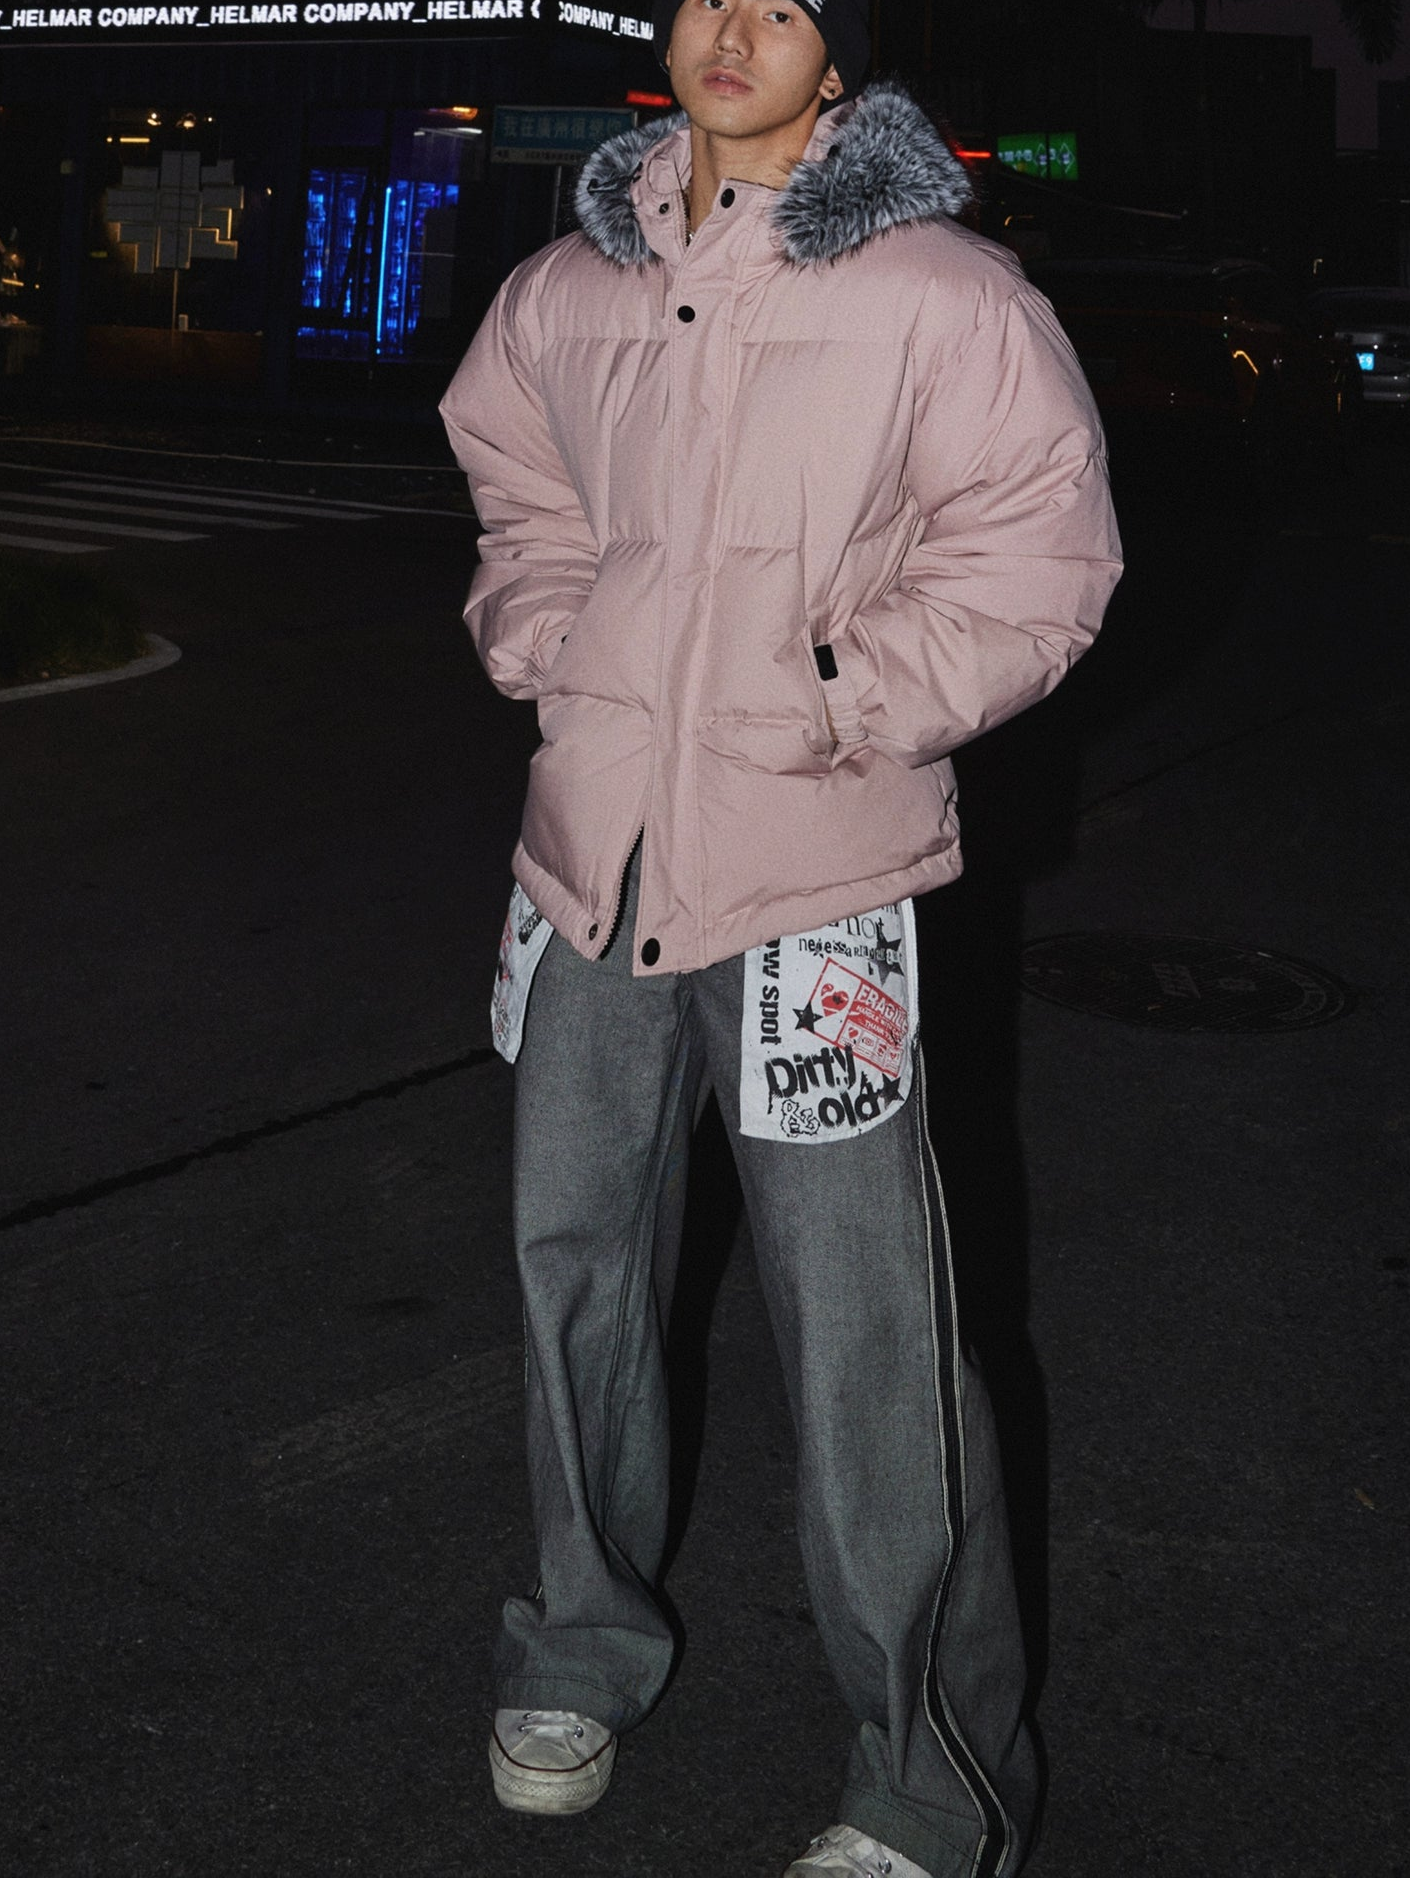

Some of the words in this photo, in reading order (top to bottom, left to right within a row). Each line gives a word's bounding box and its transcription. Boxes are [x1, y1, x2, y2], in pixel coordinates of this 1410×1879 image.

[98, 4, 298, 27] COMPANY_HELMAR
[304, 0, 523, 23] COMPANY_HELMAR
[760, 984, 782, 1045] spot
[857, 983, 908, 1032] FRAGILE
[765, 1045, 858, 1103] Dirty
